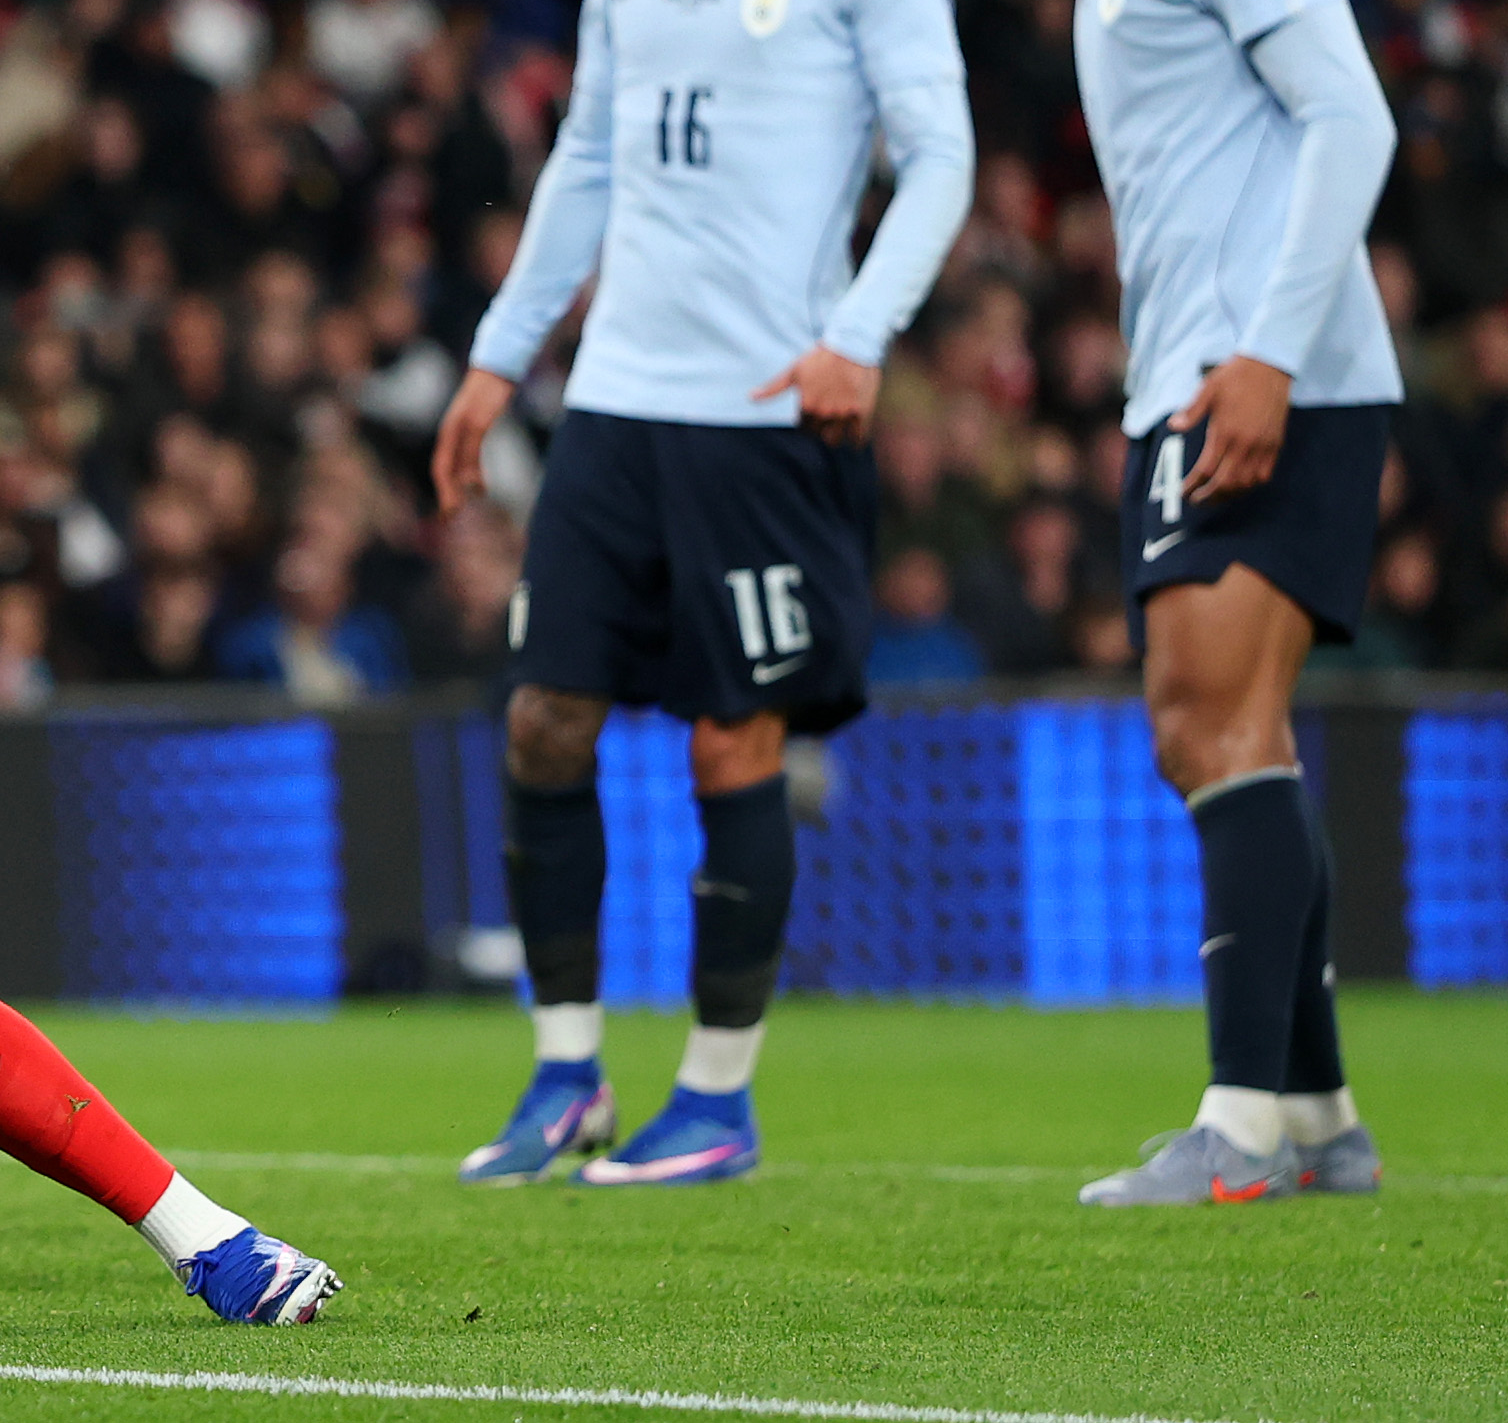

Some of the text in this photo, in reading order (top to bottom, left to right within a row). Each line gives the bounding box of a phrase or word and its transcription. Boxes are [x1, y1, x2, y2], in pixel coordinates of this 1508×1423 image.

[656, 83, 714, 170] 16
[1148, 434, 1185, 524] 4
[724, 563, 813, 659] 16
